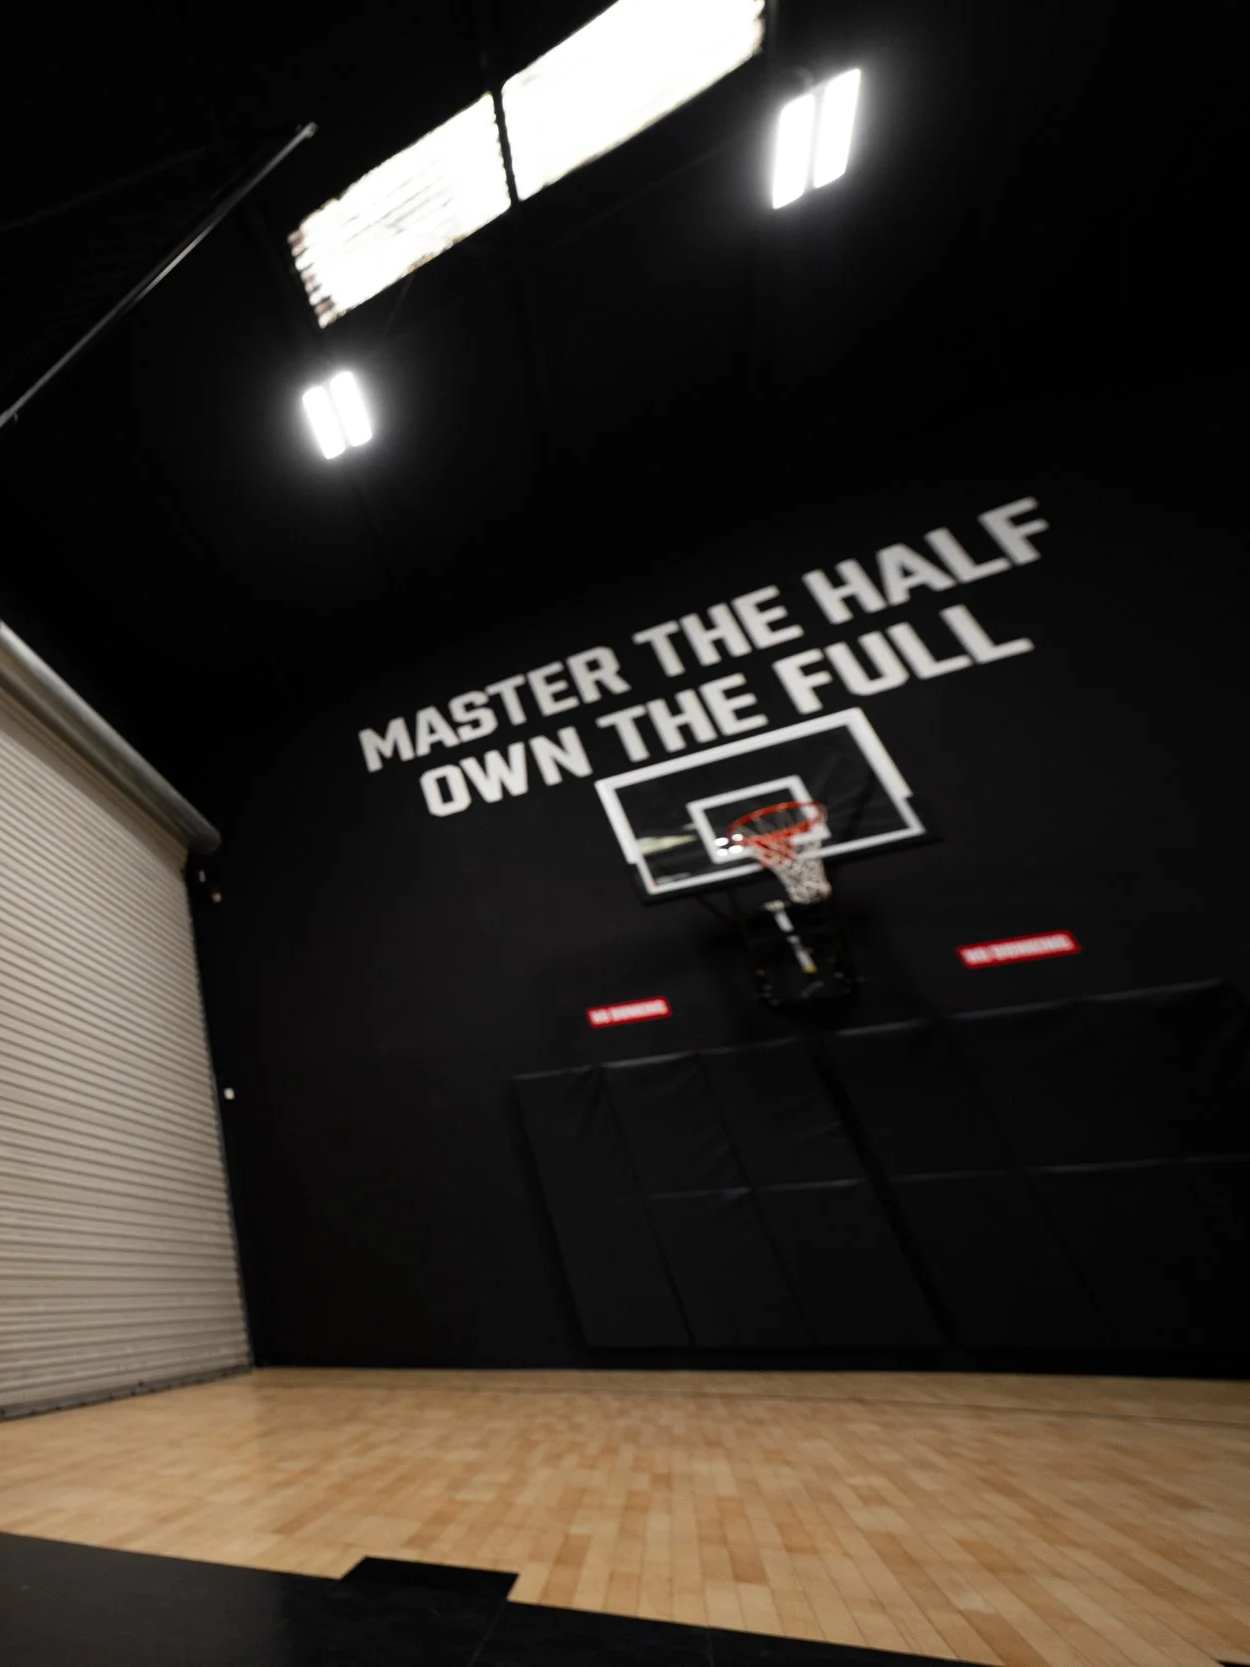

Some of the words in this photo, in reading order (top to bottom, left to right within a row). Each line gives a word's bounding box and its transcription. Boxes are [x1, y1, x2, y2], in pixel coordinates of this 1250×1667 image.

[359, 646, 630, 773] MASTER
[633, 585, 804, 677] THE
[803, 498, 1049, 624] HALF
[420, 726, 593, 817] OWN
[596, 673, 769, 762] THE
[772, 605, 1034, 715] FULL
